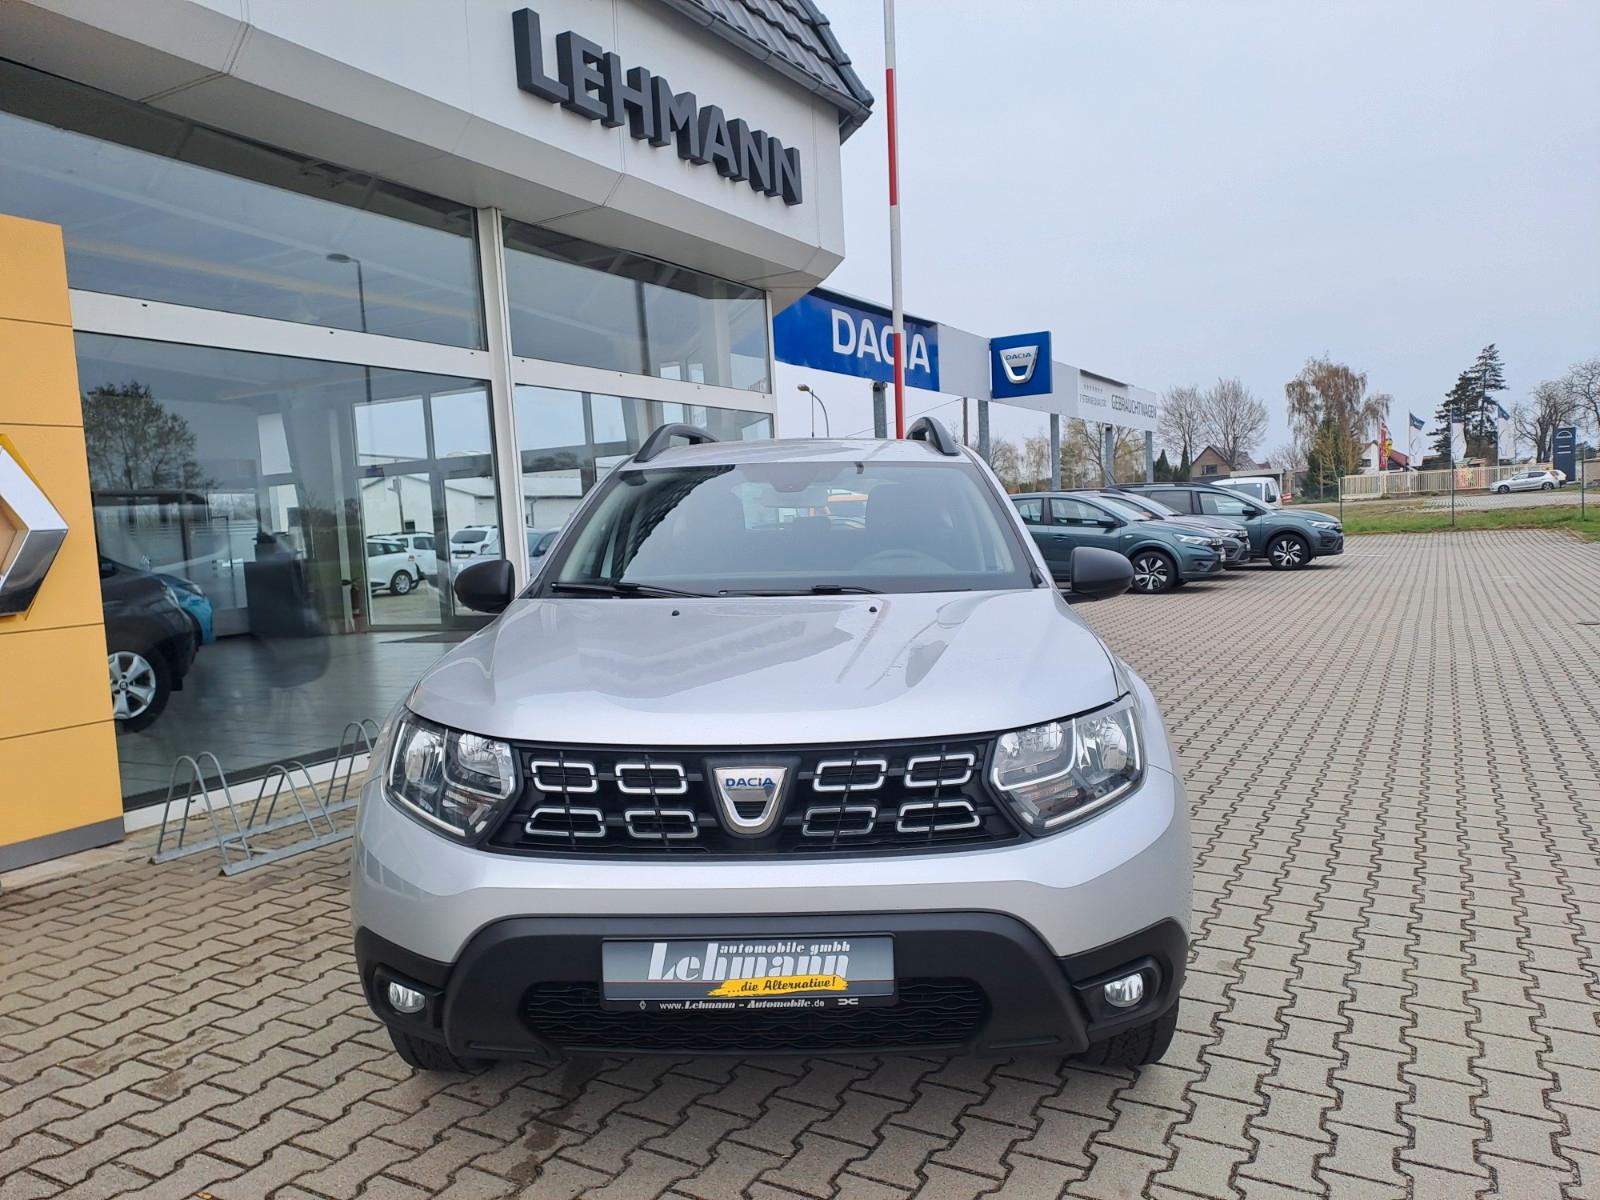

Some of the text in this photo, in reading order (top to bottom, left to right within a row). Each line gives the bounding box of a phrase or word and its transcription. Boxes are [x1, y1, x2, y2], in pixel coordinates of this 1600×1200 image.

[512, 8, 803, 205] LEHMANN
[831, 308, 931, 374] DACIA
[1005, 352, 1032, 361] DACIA
[725, 777, 775, 788] DACIA
[719, 941, 850, 955] automobile gmbh
[648, 943, 849, 981] Lehmann
[763, 976, 836, 991] Alternative!
